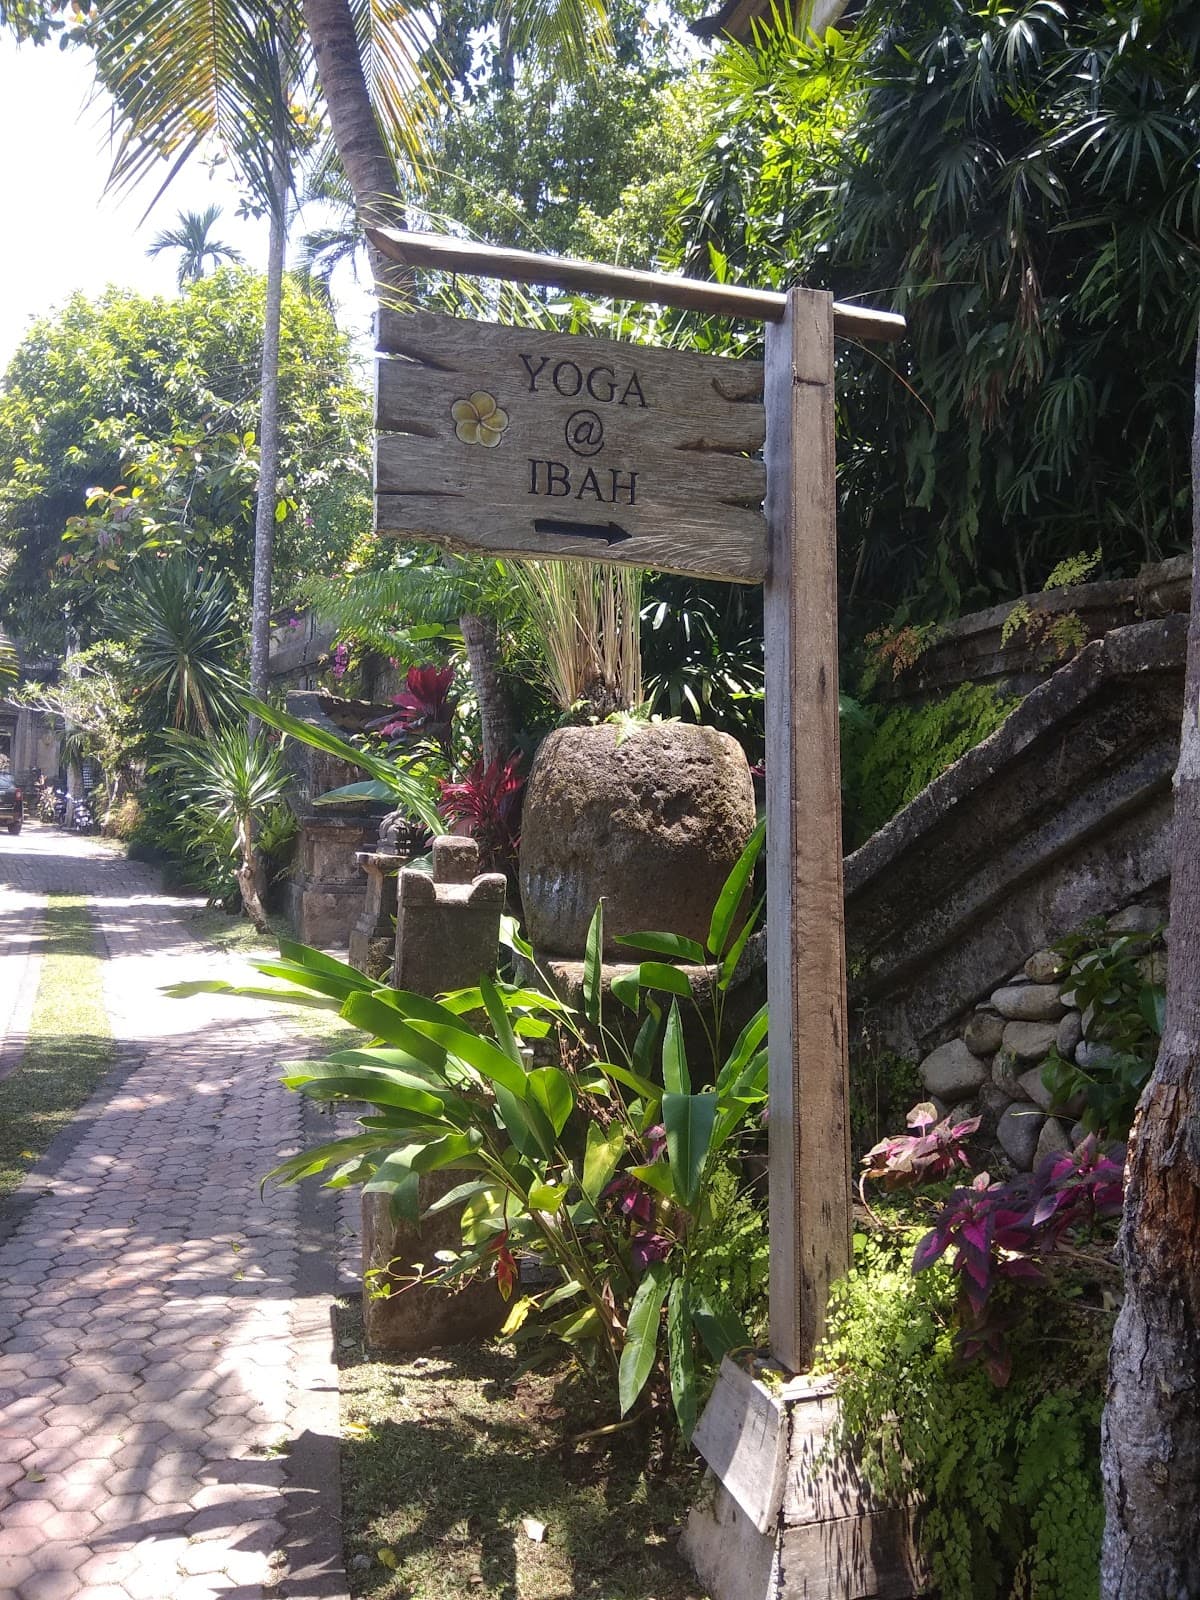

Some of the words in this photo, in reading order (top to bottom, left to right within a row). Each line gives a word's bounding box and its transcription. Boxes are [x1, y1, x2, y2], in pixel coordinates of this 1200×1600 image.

[518, 353, 649, 409] YOGA
[565, 409, 605, 457] @
[527, 458, 640, 506] IBAH
